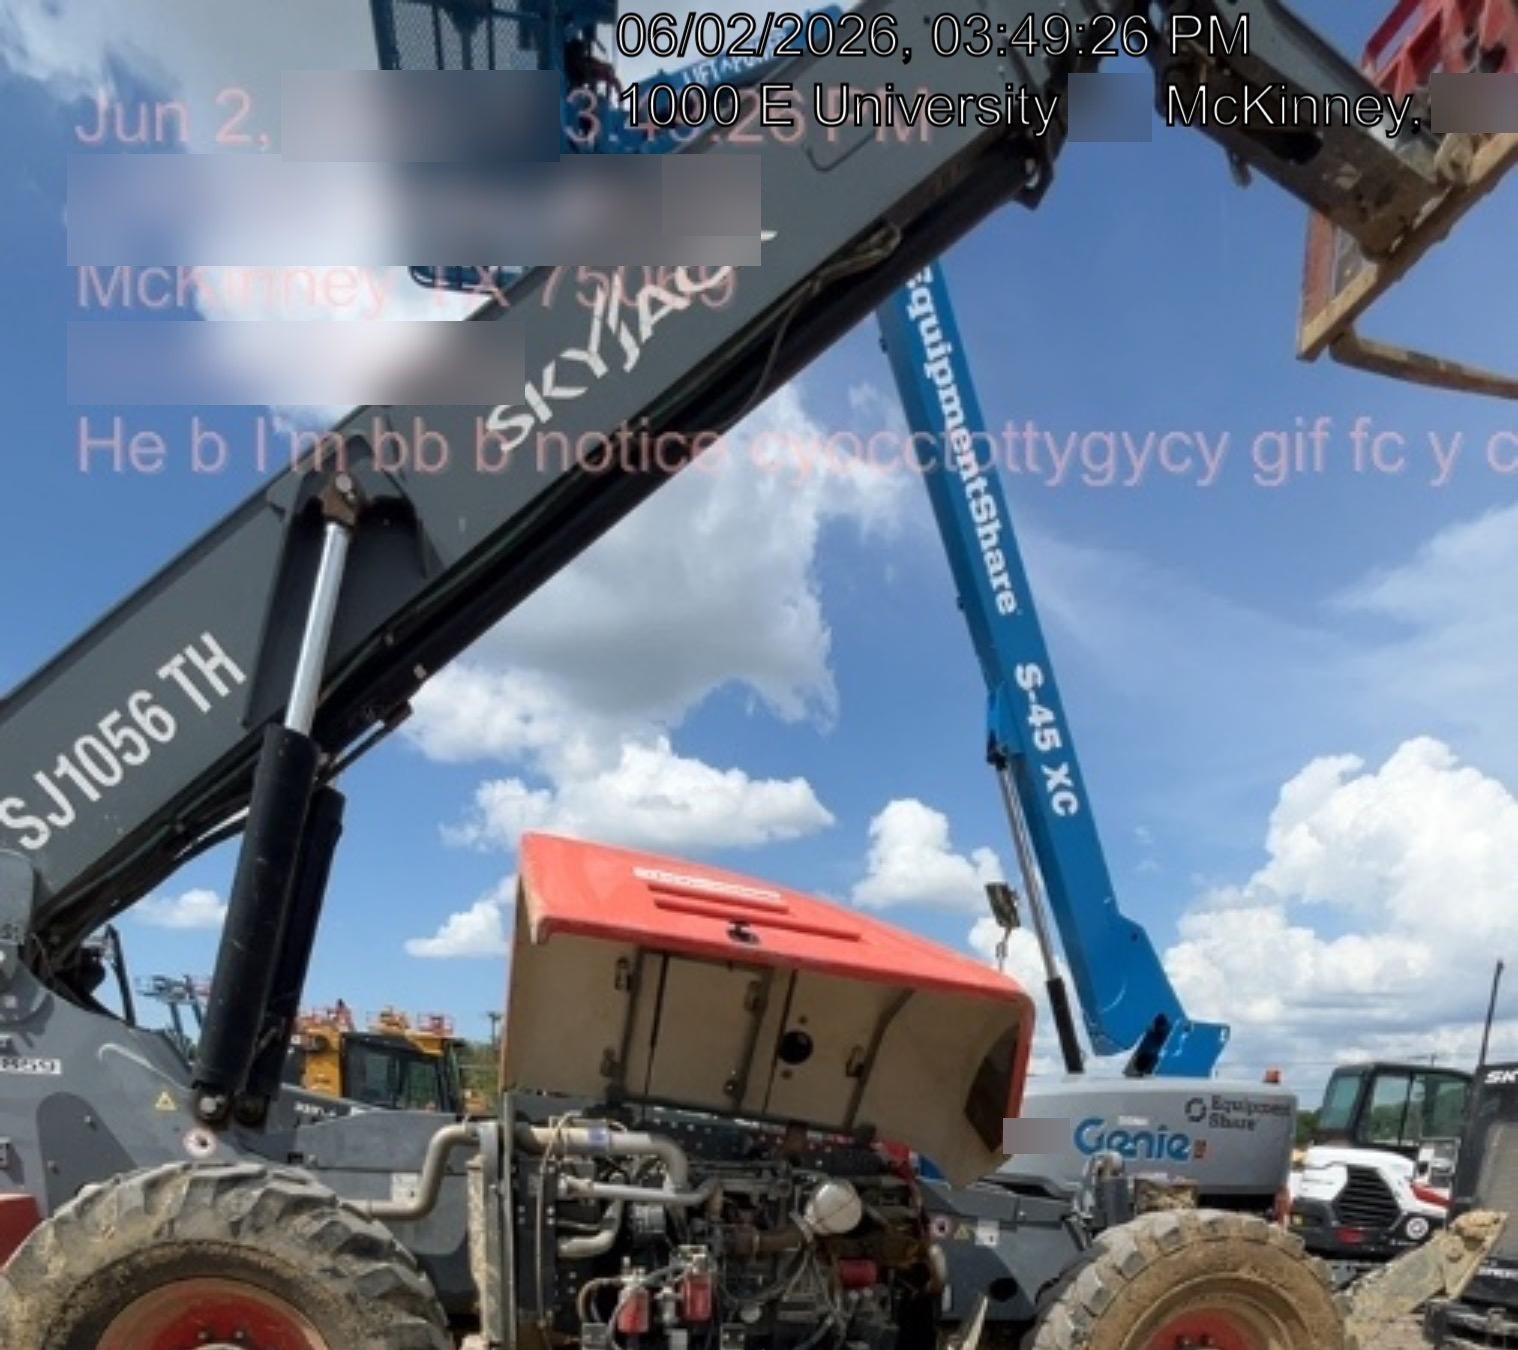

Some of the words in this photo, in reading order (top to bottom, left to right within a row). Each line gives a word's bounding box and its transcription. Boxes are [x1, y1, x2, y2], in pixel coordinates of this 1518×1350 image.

[0, 689, 177, 851] SJ1056
[156, 630, 248, 714] TH
[1015, 662, 1063, 752] S-45
[1041, 762, 1079, 816] XC
[1074, 1117, 1190, 1161] Genie
